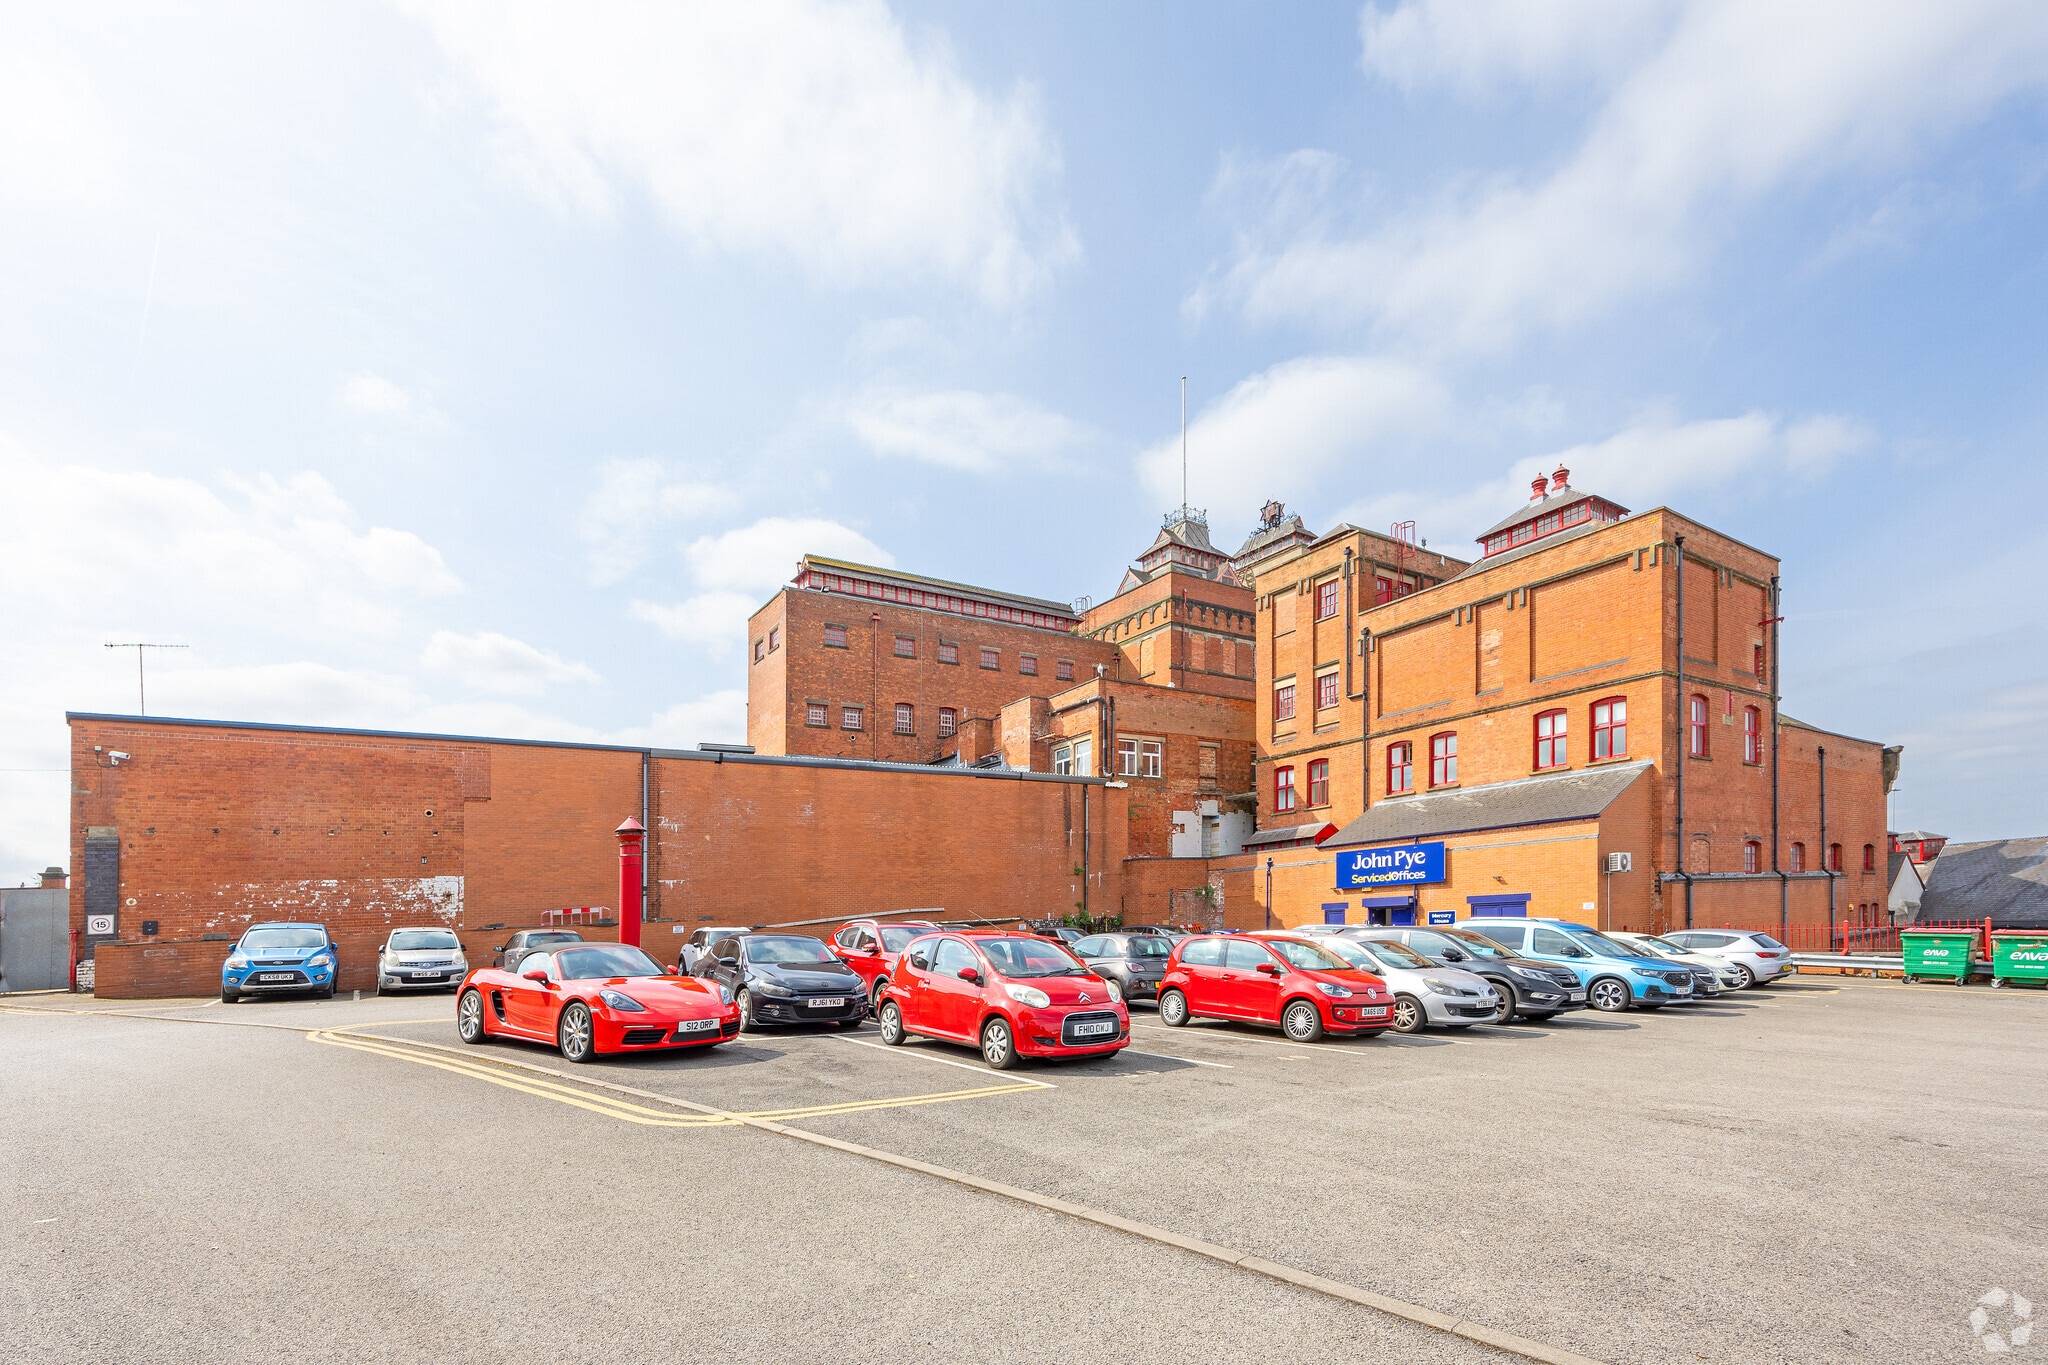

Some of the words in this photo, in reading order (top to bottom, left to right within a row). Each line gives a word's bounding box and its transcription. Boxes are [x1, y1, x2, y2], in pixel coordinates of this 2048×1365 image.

[1352, 852, 1392, 870] John
[1394, 850, 1426, 869] Pye
[95, 921, 107, 929] 15
[686, 1022, 699, 1030] S12
[1078, 1024, 1095, 1035] FH10
